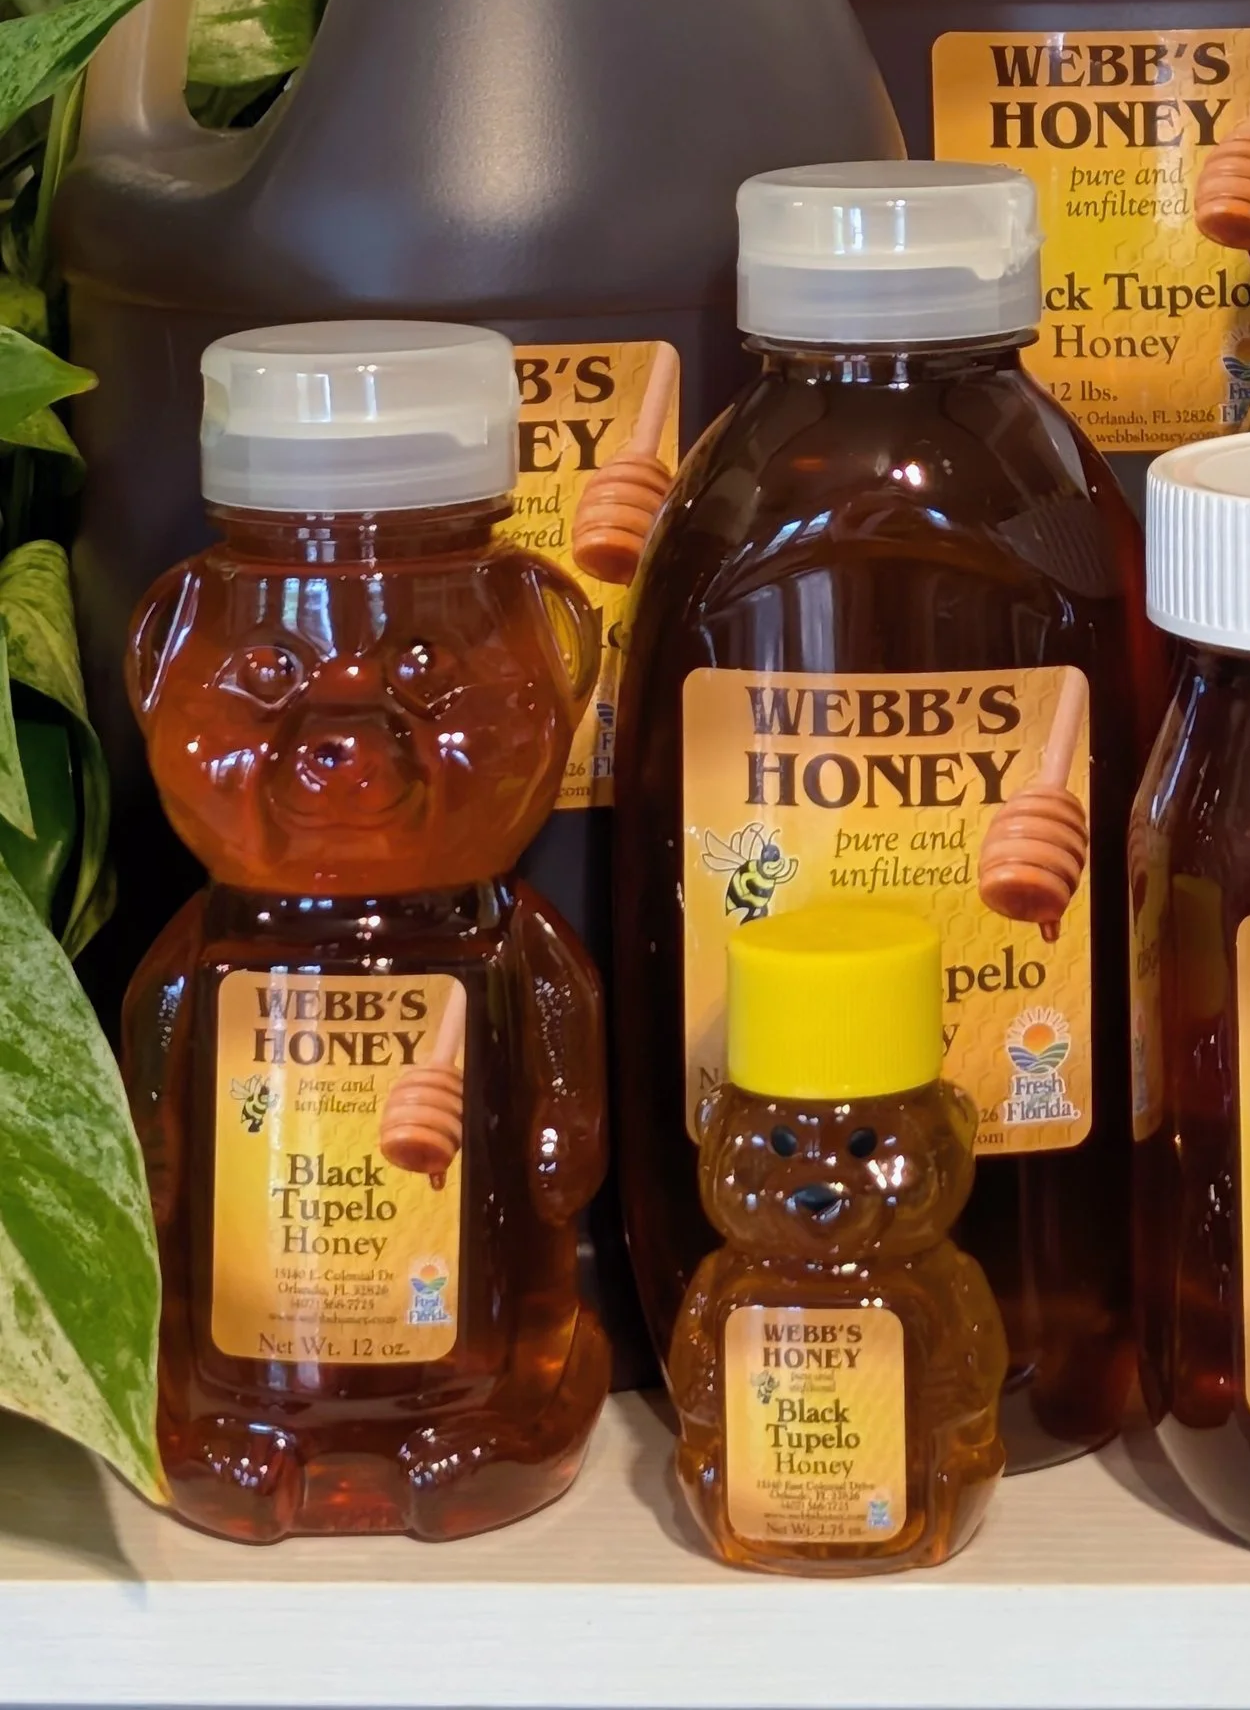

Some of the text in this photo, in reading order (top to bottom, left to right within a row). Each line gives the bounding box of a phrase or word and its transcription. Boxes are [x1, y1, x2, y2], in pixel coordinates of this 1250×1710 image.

[989, 41, 1230, 87] WEBB'S
[989, 98, 1230, 149] HONEY
[1070, 157, 1183, 191] pure and
[1066, 189, 1189, 222] unfiltered
[1051, 324, 1180, 364] Honey
[515, 355, 615, 404] B'S
[1081, 381, 1118, 401] lbs.
[1087, 410, 1147, 426] Orlando,
[1153, 410, 1170, 423] FL
[1176, 408, 1215, 422] 32826
[745, 684, 1021, 737] WEBB'S
[744, 750, 1021, 809] HONEY
[835, 819, 966, 858] pure and
[830, 854, 972, 893] unfiltered
[945, 945, 1046, 1003] pelo
[256, 987, 427, 1022] WEBB'S
[253, 1029, 426, 1066] HONEY
[298, 1075, 375, 1095] pure and
[1015, 1072, 1063, 1095] Fresh
[295, 1094, 377, 1115] unfiltered
[286, 1153, 385, 1187] Black
[272, 1187, 397, 1226] Tupelo
[282, 1225, 387, 1259] Honey
[258, 1333, 410, 1356] Net Wt. 12 oz.
[763, 1323, 863, 1343] WEBB'S
[763, 1347, 862, 1369] HONEY
[775, 1397, 850, 1423] Black
[765, 1424, 861, 1454] Tupelo
[775, 1452, 855, 1478] Honey
